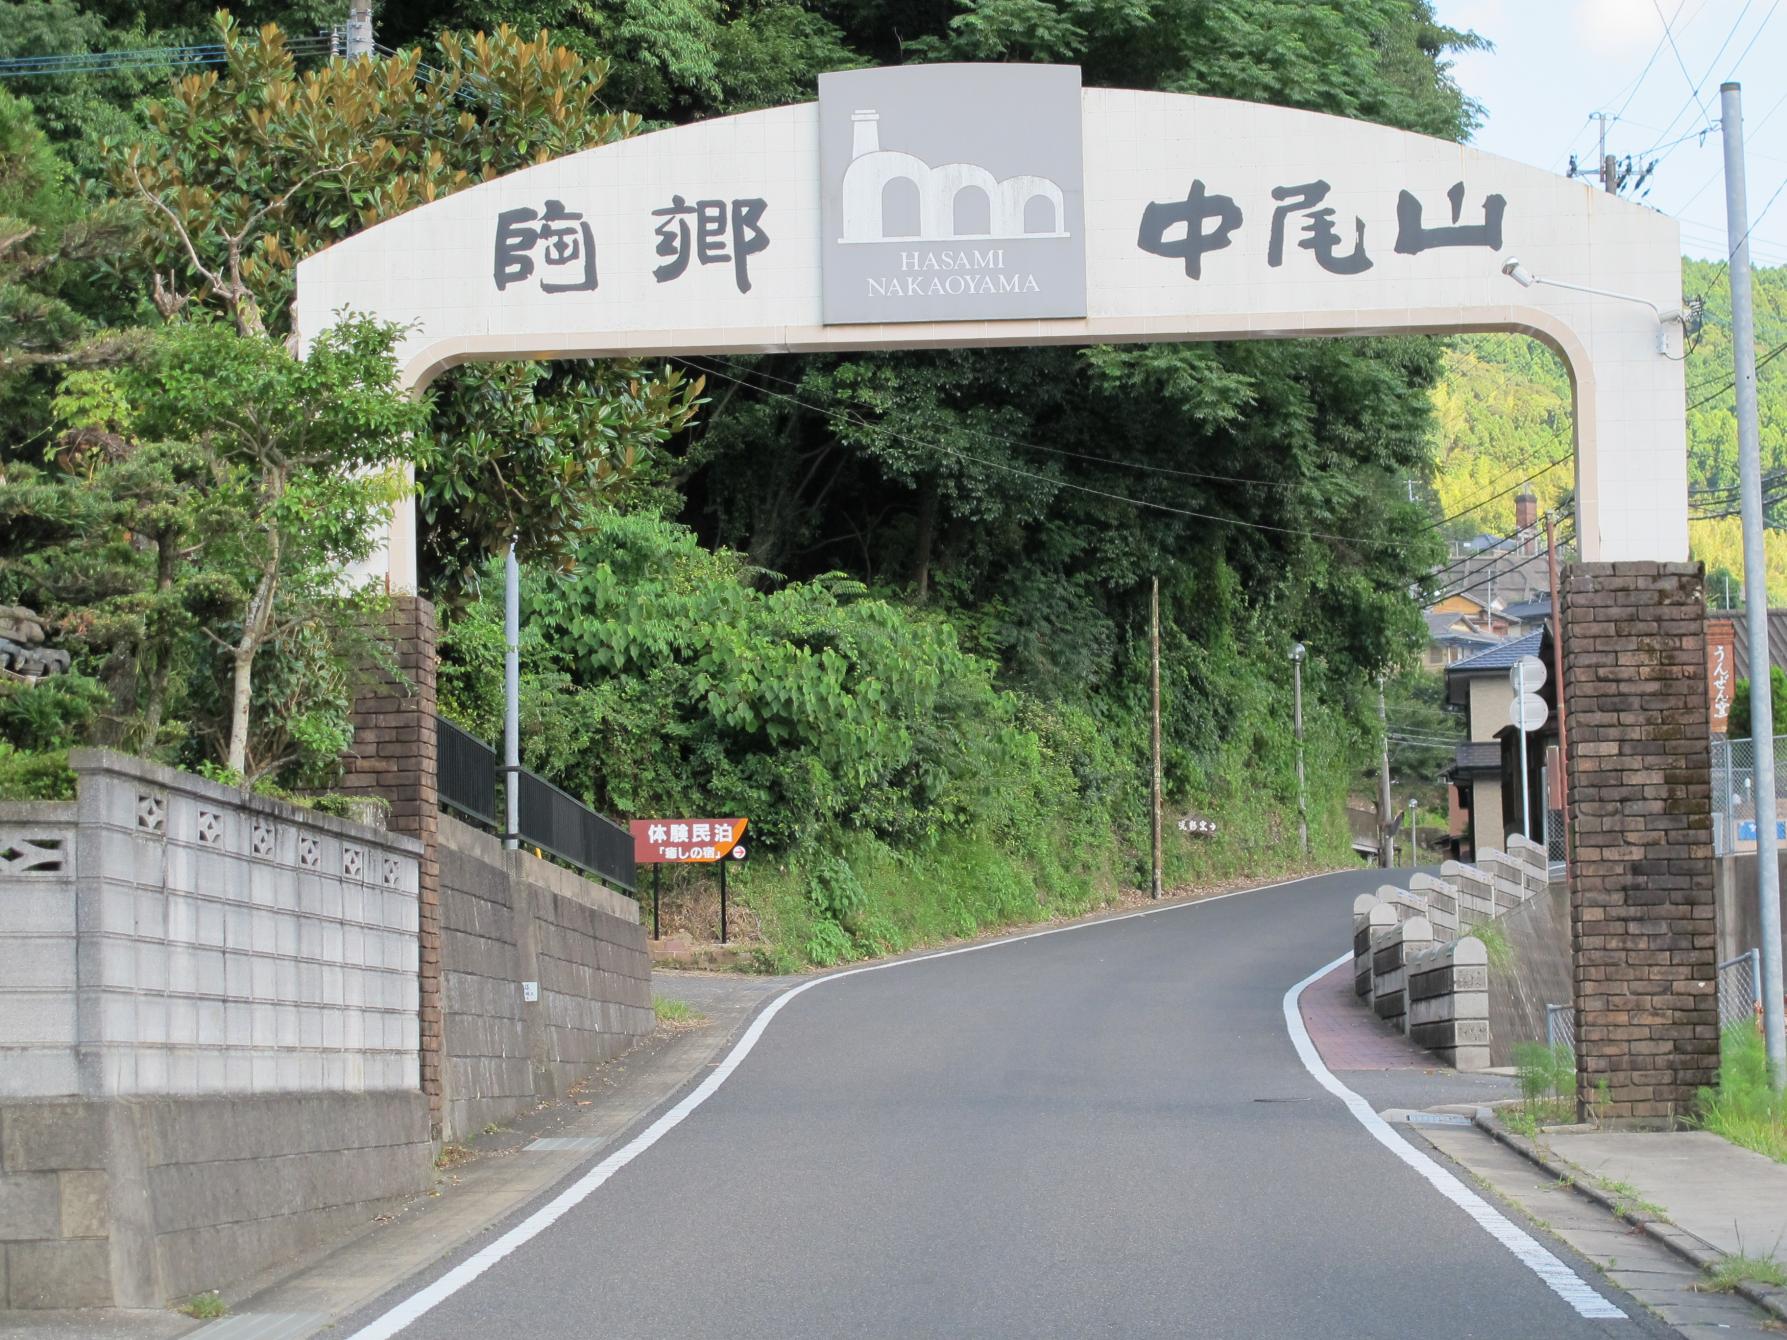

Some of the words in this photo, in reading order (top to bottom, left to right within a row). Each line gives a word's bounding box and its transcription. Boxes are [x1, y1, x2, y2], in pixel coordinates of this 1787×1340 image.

[1137, 178, 1507, 281] 中尾山
[900, 249, 1005, 271] HASAMI
[867, 273, 1041, 297] NAKAOYAMA
[648, 823, 733, 843] 体験民泊
